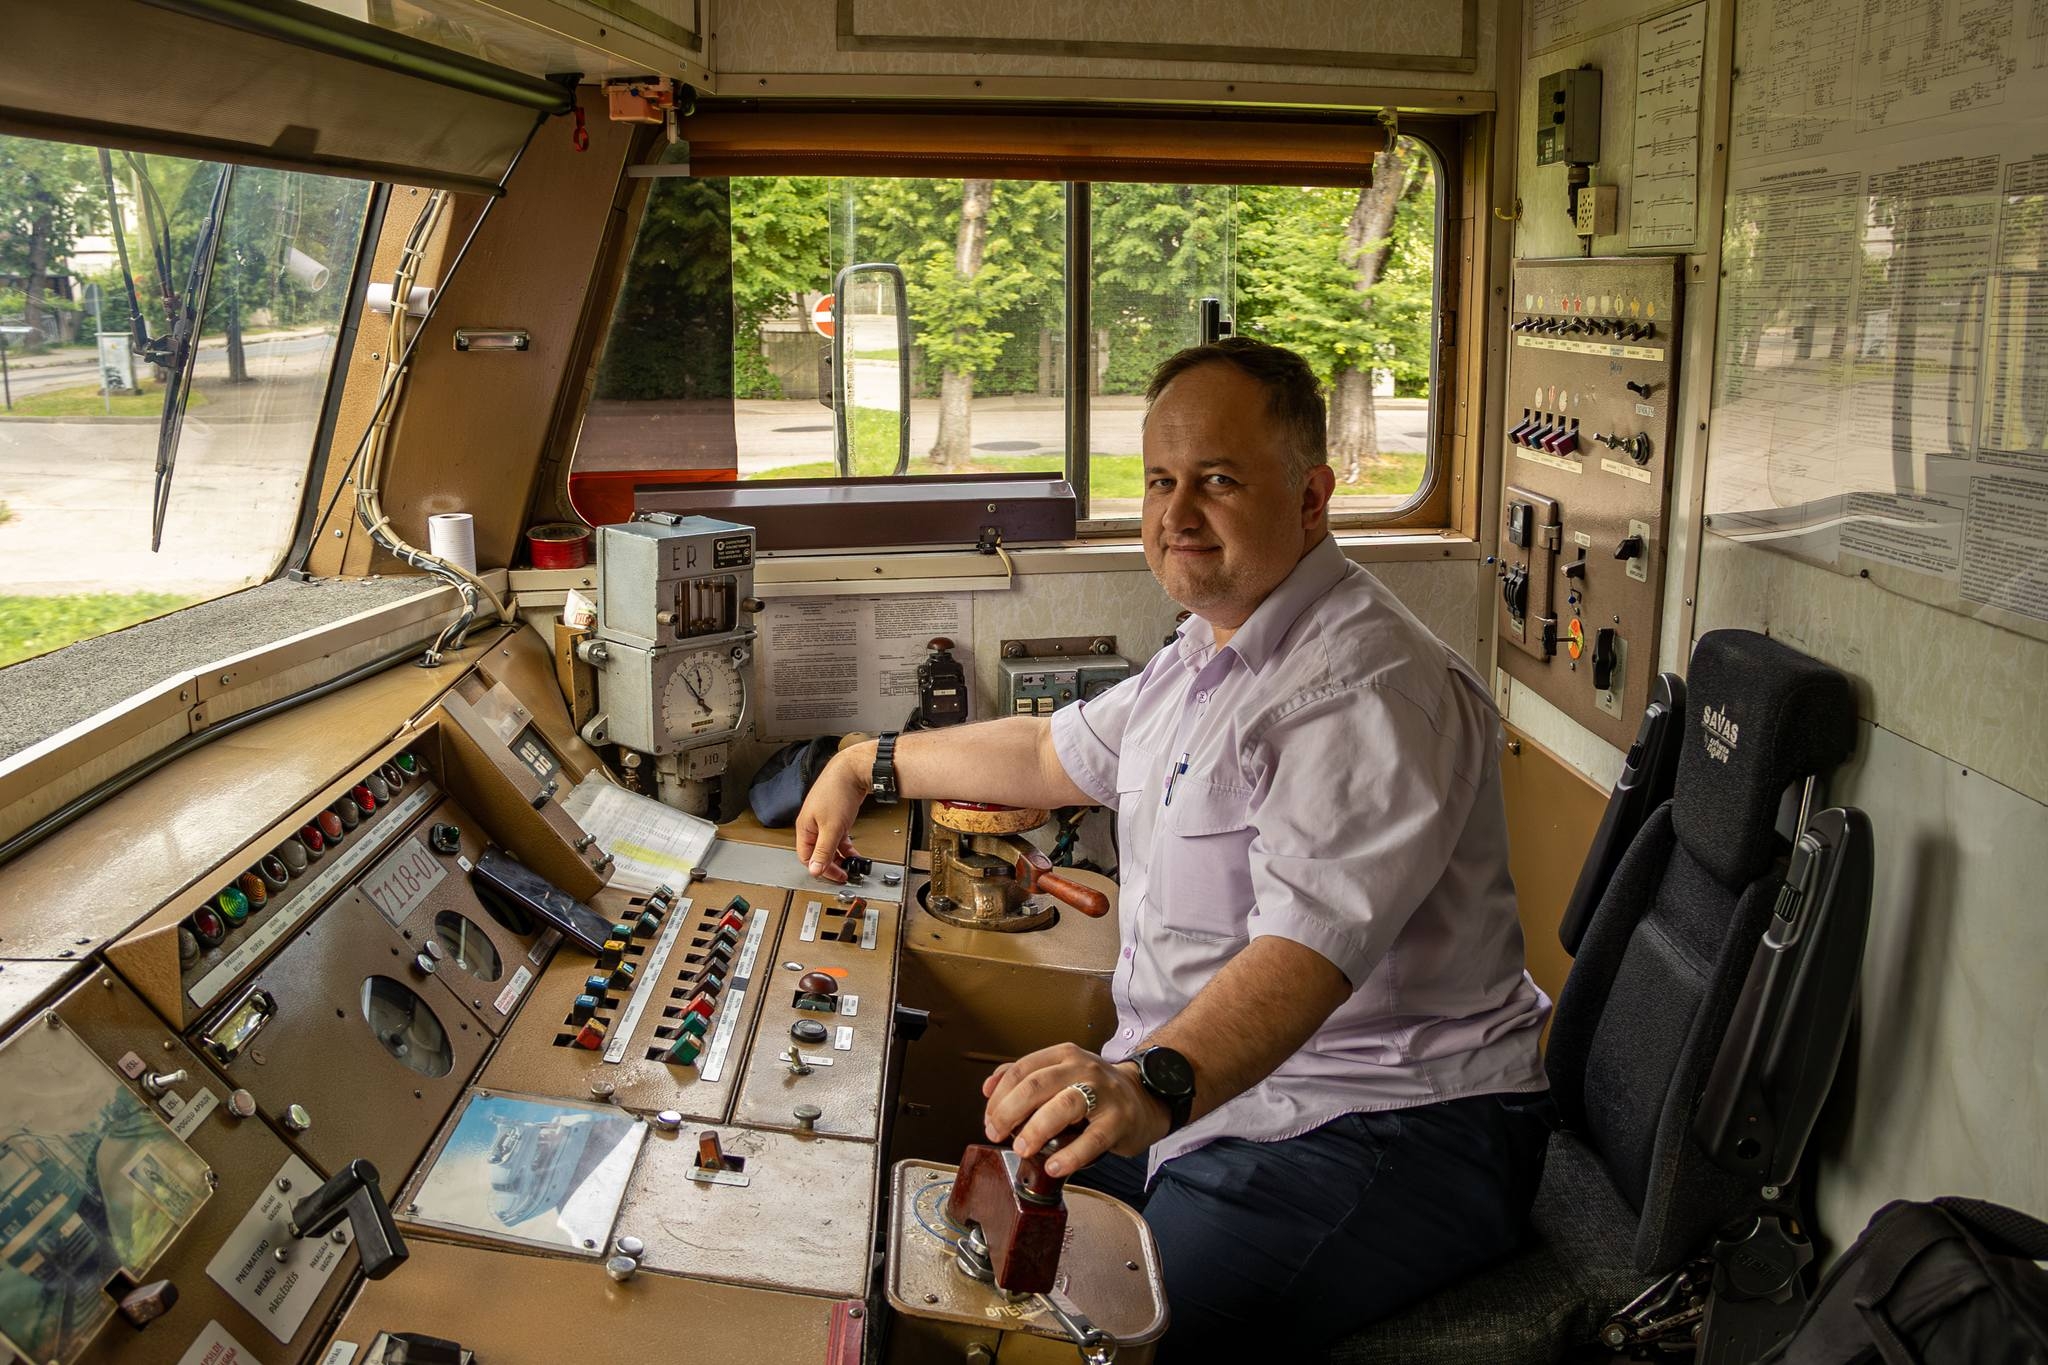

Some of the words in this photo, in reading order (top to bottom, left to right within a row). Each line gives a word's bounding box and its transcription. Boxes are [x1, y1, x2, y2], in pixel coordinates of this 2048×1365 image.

[373, 847, 440, 917] 7118-01
[235, 1239, 270, 1285] PNEIMATISKO
[254, 1266, 278, 1297] BREMŽU
[268, 1271, 300, 1315] PĀRSLĒDZĒJS
